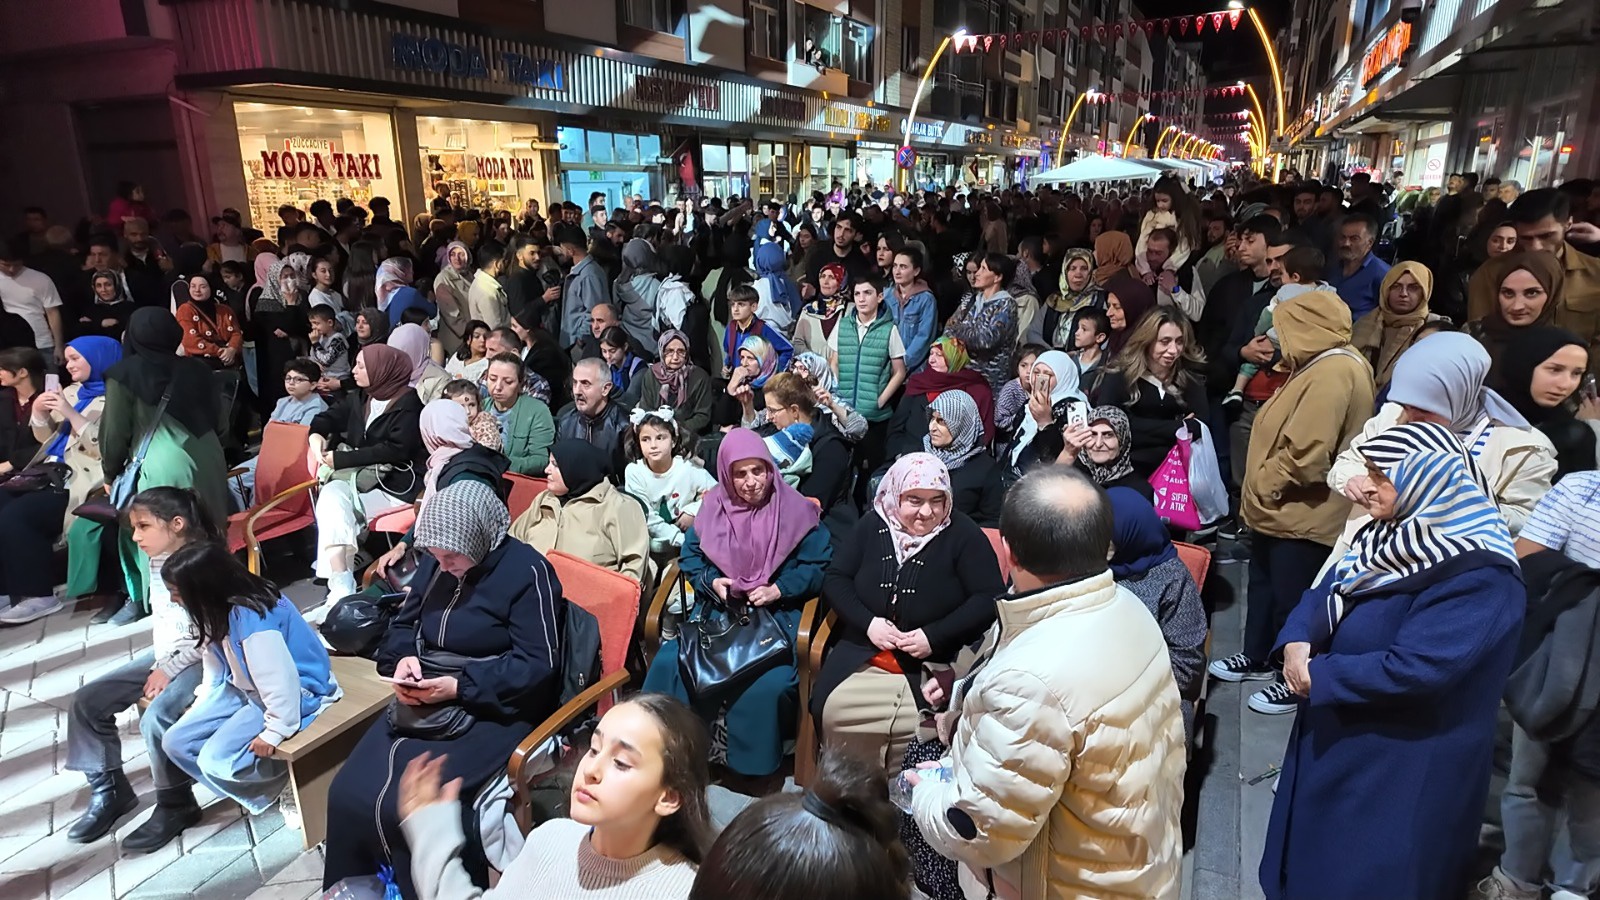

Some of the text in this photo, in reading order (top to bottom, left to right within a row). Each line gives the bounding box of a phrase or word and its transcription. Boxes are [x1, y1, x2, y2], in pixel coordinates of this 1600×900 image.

[392, 32, 563, 90] MODA TAKI
[261, 150, 382, 179] MODA TAKI
[476, 156, 535, 180] MODA TAKI
[1170, 502, 1186, 512] ATIK
[1171, 492, 1188, 503] SIFIR
